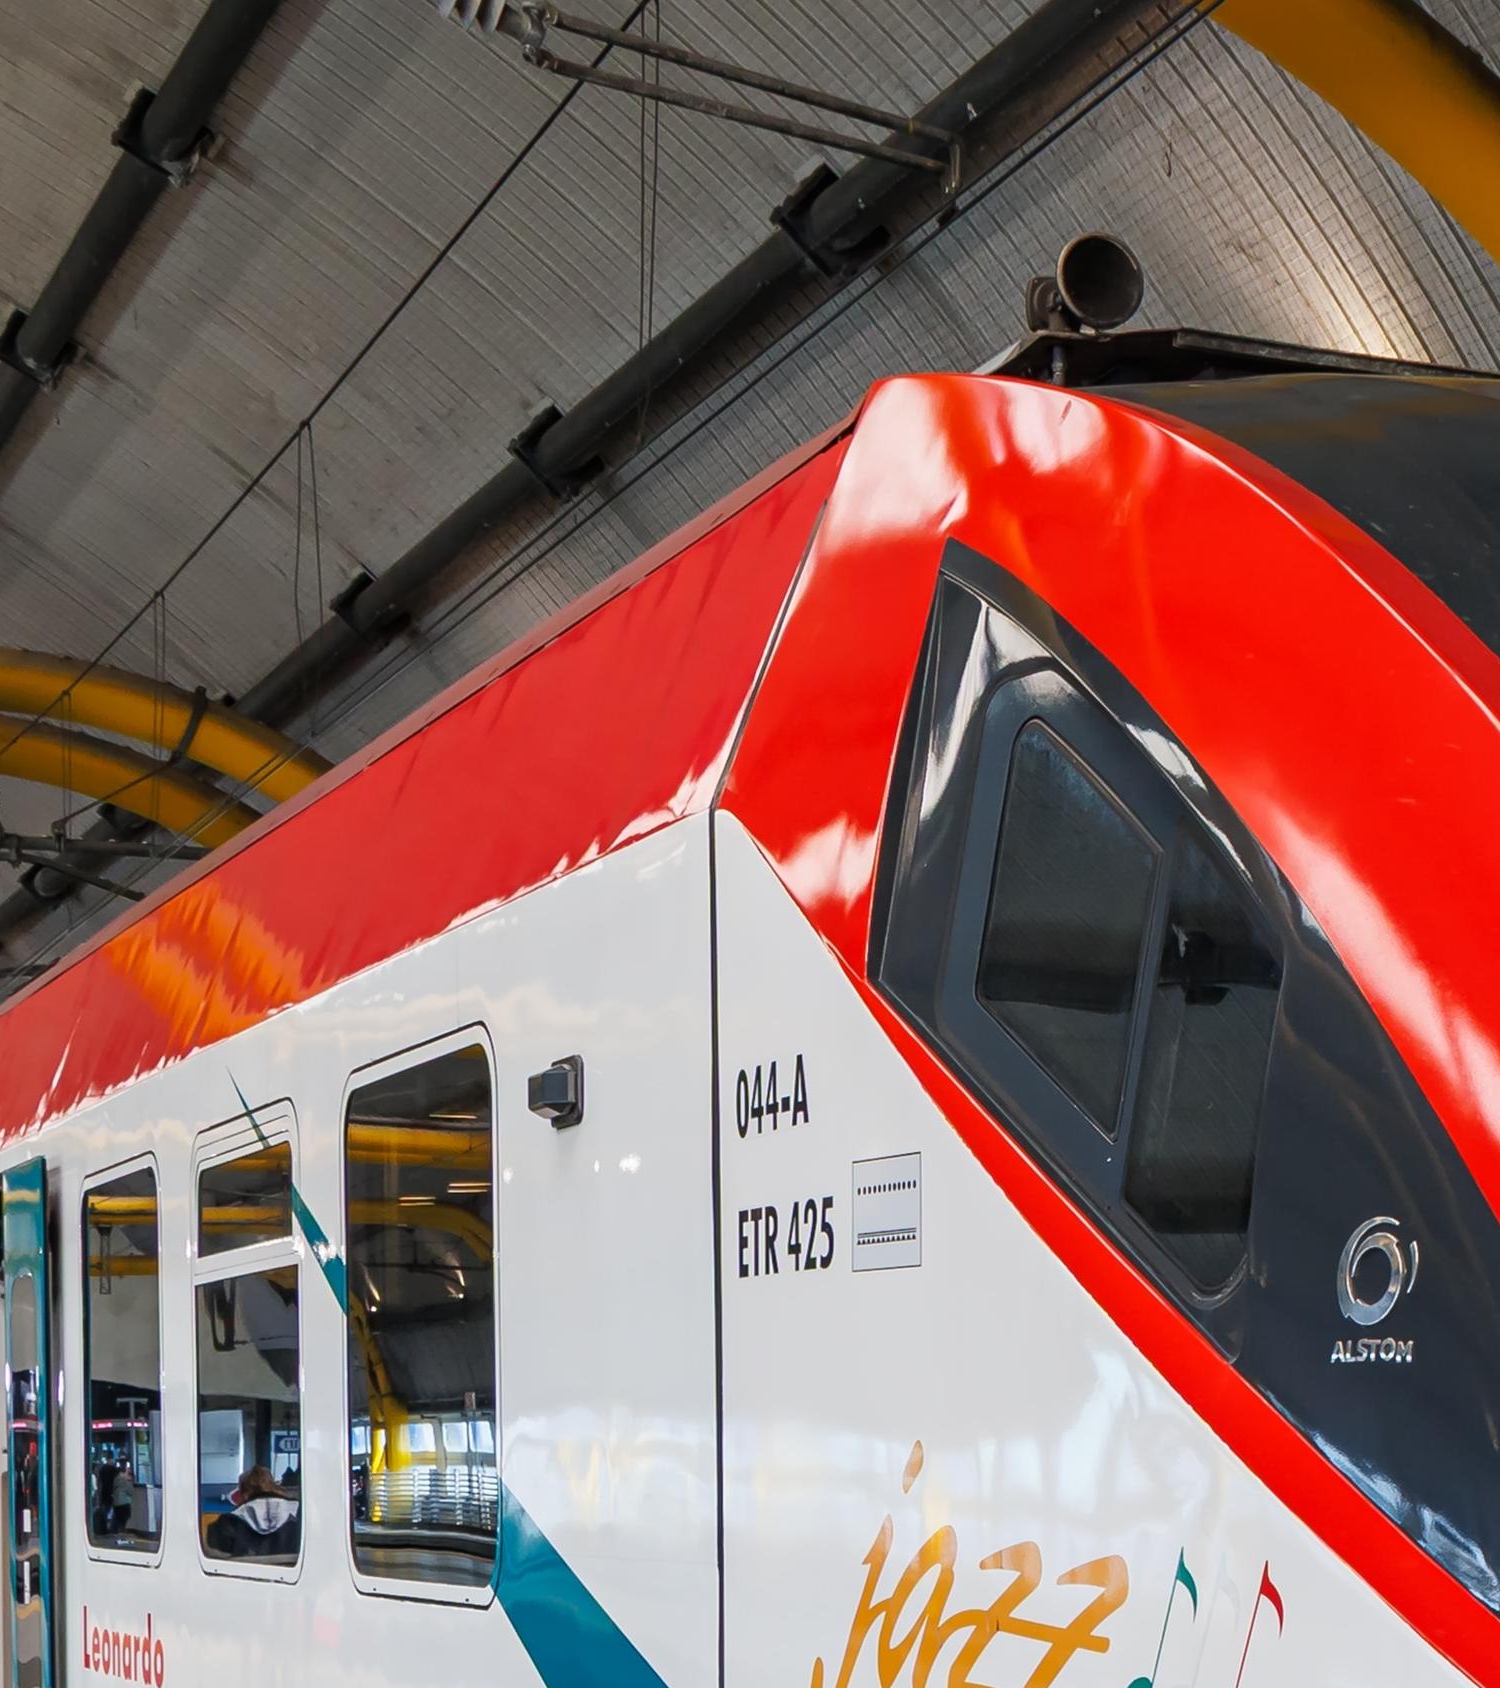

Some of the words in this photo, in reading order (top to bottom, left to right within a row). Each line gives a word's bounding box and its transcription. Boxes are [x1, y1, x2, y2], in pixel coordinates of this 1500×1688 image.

[736, 1054, 809, 1138] 044-A
[738, 1205, 779, 1278] ETR
[787, 1195, 834, 1272] 425
[1330, 1337, 1414, 1364] ALSTOM
[83, 1605, 165, 1688] Leonardo
